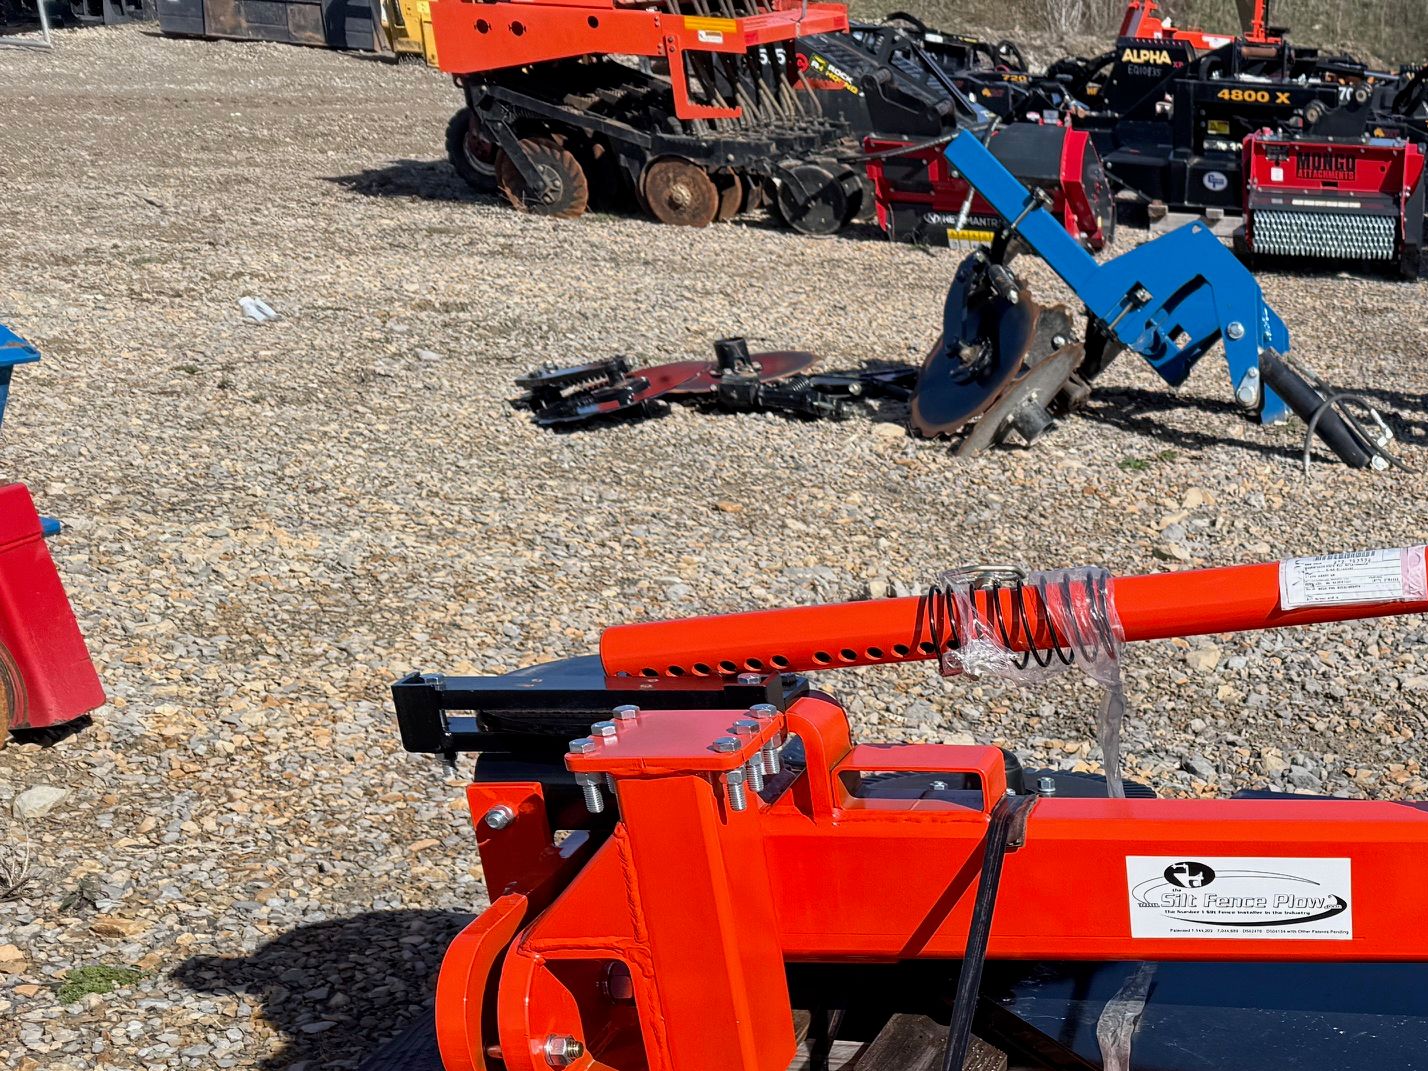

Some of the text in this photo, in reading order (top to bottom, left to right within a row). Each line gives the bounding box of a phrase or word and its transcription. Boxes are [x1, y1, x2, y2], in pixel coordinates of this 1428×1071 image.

[1121, 48, 1172, 66] ALPHA
[1217, 88, 1290, 104] 4800 X
[1296, 152, 1356, 172] MONGO
[1296, 169, 1354, 180] ATTACHMENTS
[1160, 892, 1197, 908] Silt
[1203, 892, 1267, 908] Fence
[1273, 893, 1325, 909] Plow
